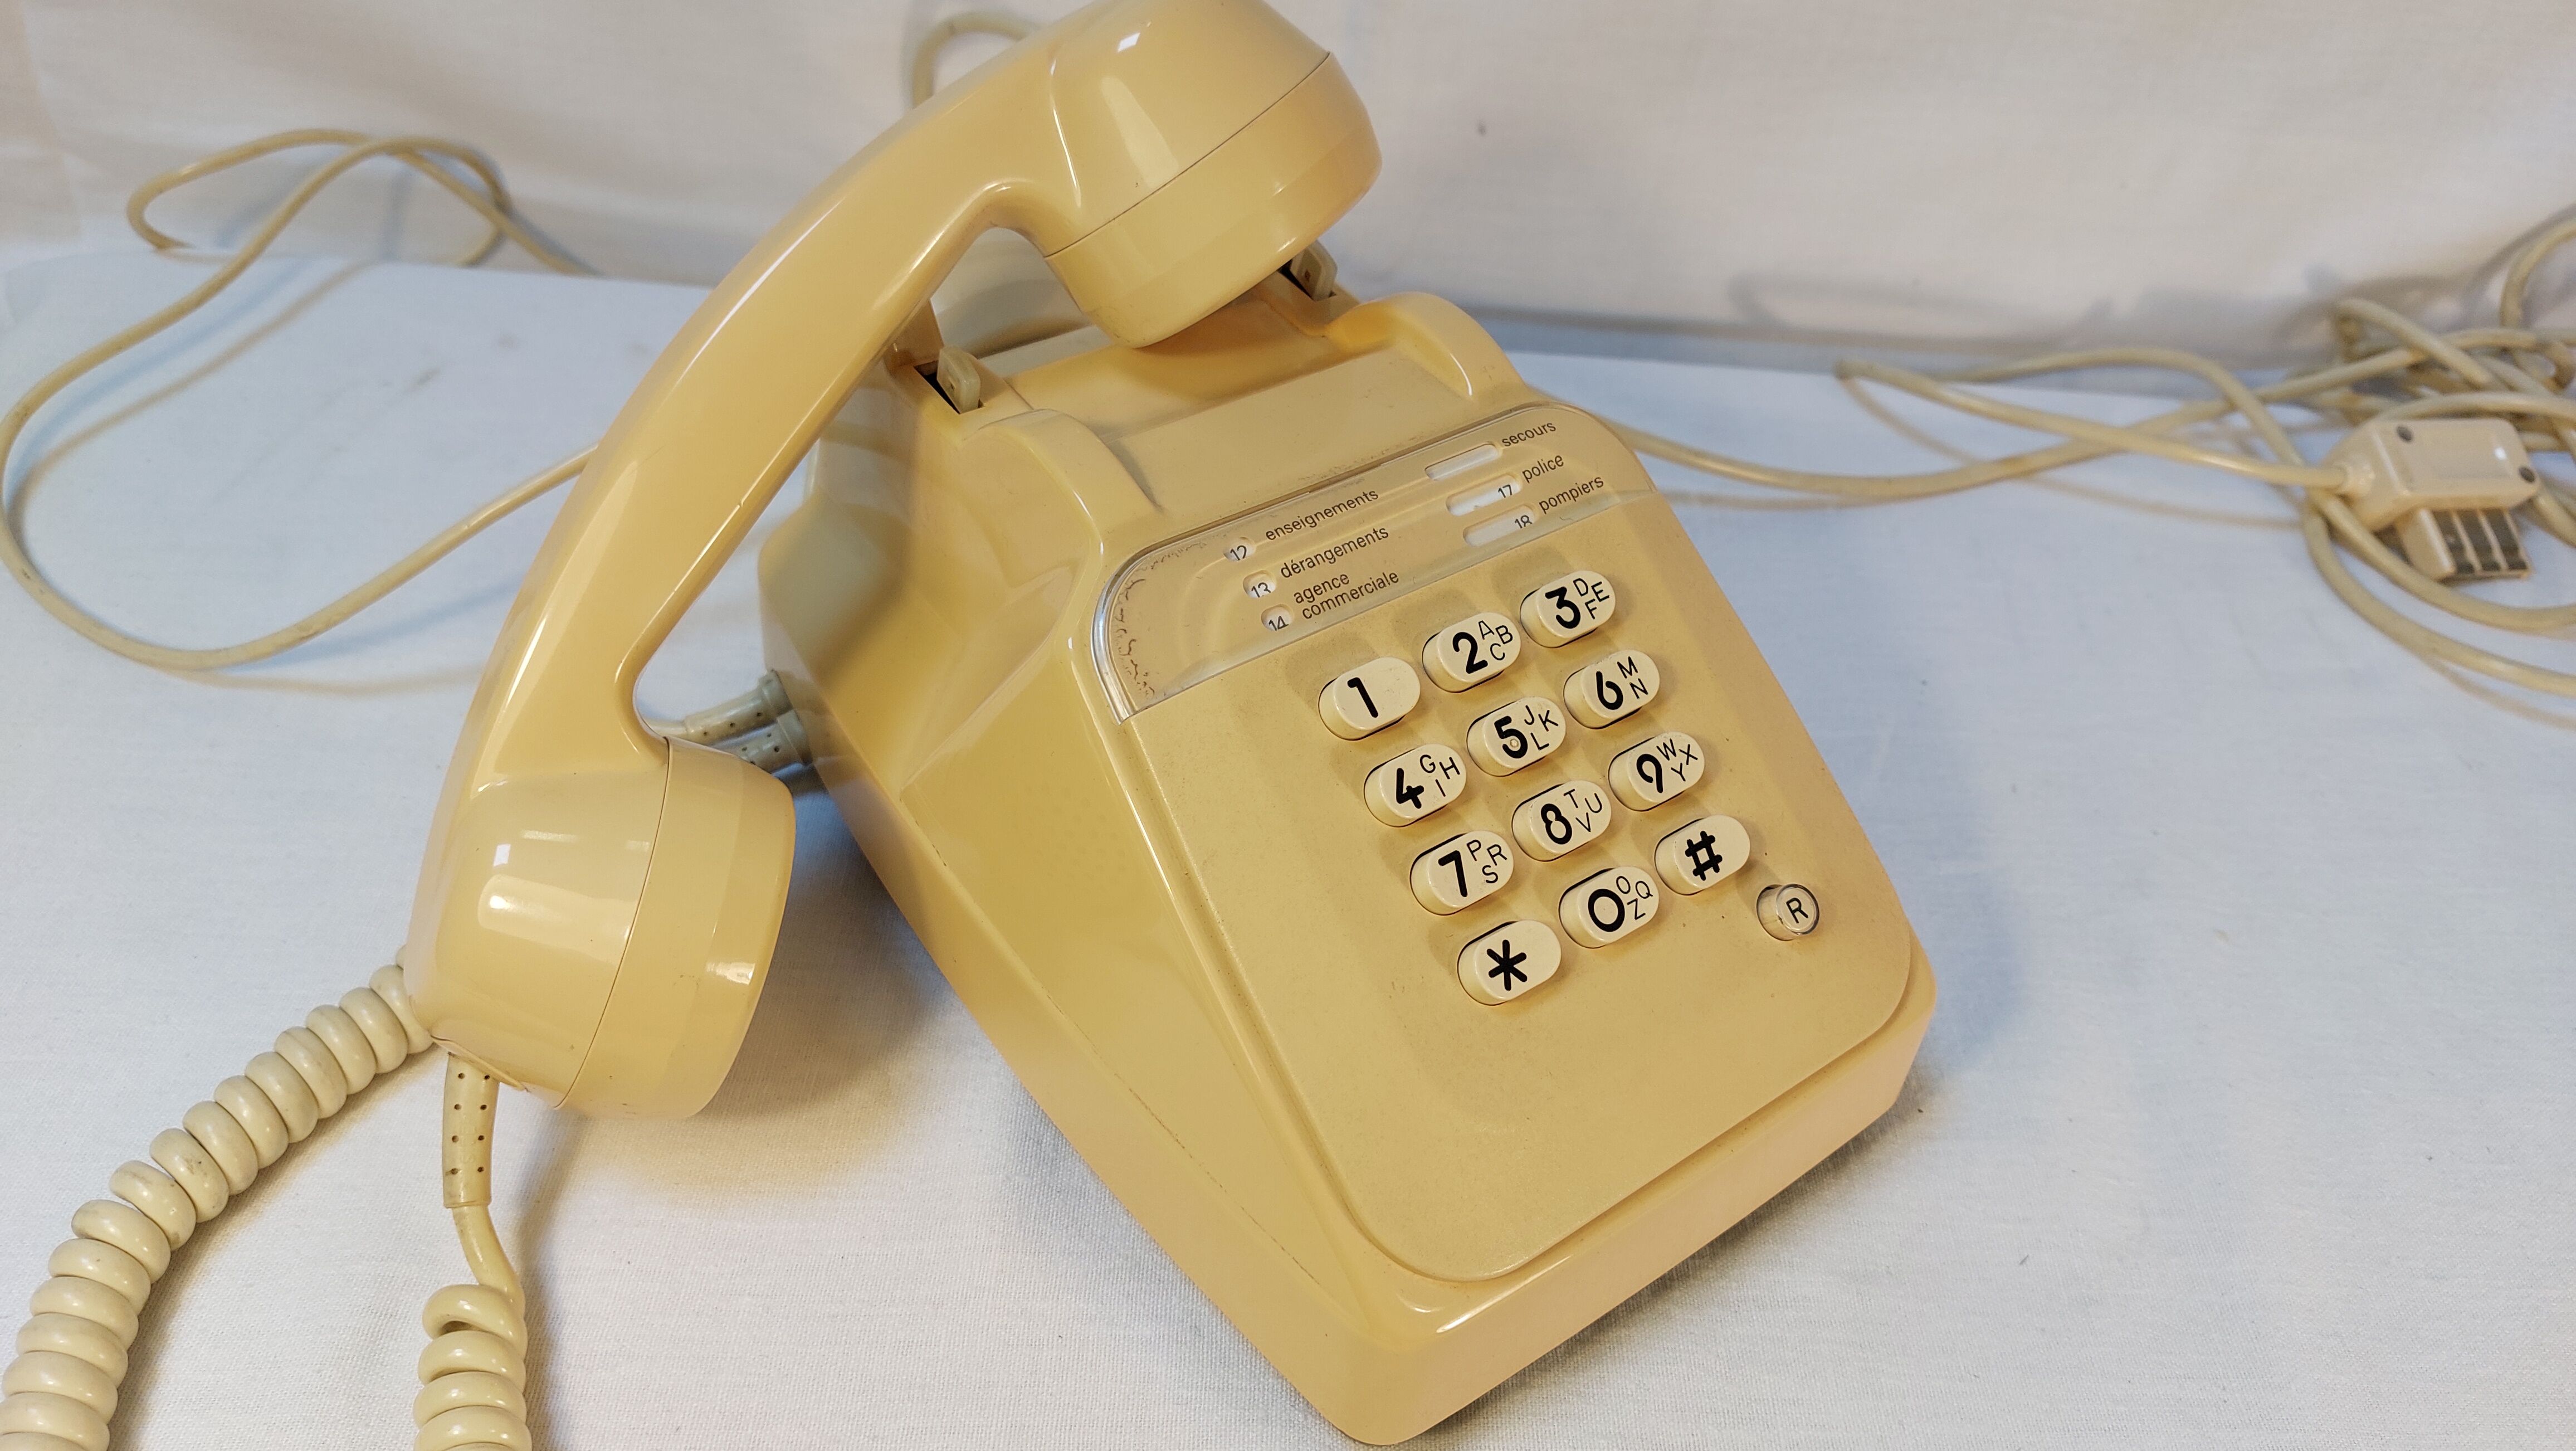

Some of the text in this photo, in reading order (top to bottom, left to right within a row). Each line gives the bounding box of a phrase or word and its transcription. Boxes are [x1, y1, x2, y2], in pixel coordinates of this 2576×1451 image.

[1501, 423, 1556, 447] secours
[1497, 455, 1564, 498] 17 police
[1539, 477, 1604, 514] pompiers
[1266, 490, 1379, 541] enseignements
[1281, 527, 1389, 578] dérangements
[1294, 574, 1350, 603] agence
[1302, 572, 1399, 619] commerciale
[1545, 587, 1580, 629] 3
[1452, 631, 1488, 674] 2
[1347, 677, 1379, 718] 1
[1596, 671, 1624, 710] 6
[1494, 716, 1528, 758] 5
[1396, 767, 1424, 809] 4
[1636, 753, 1663, 793] 9
[1540, 803, 1573, 845] 8
[1438, 850, 1468, 898] 7
[1785, 897, 1809, 924] R
